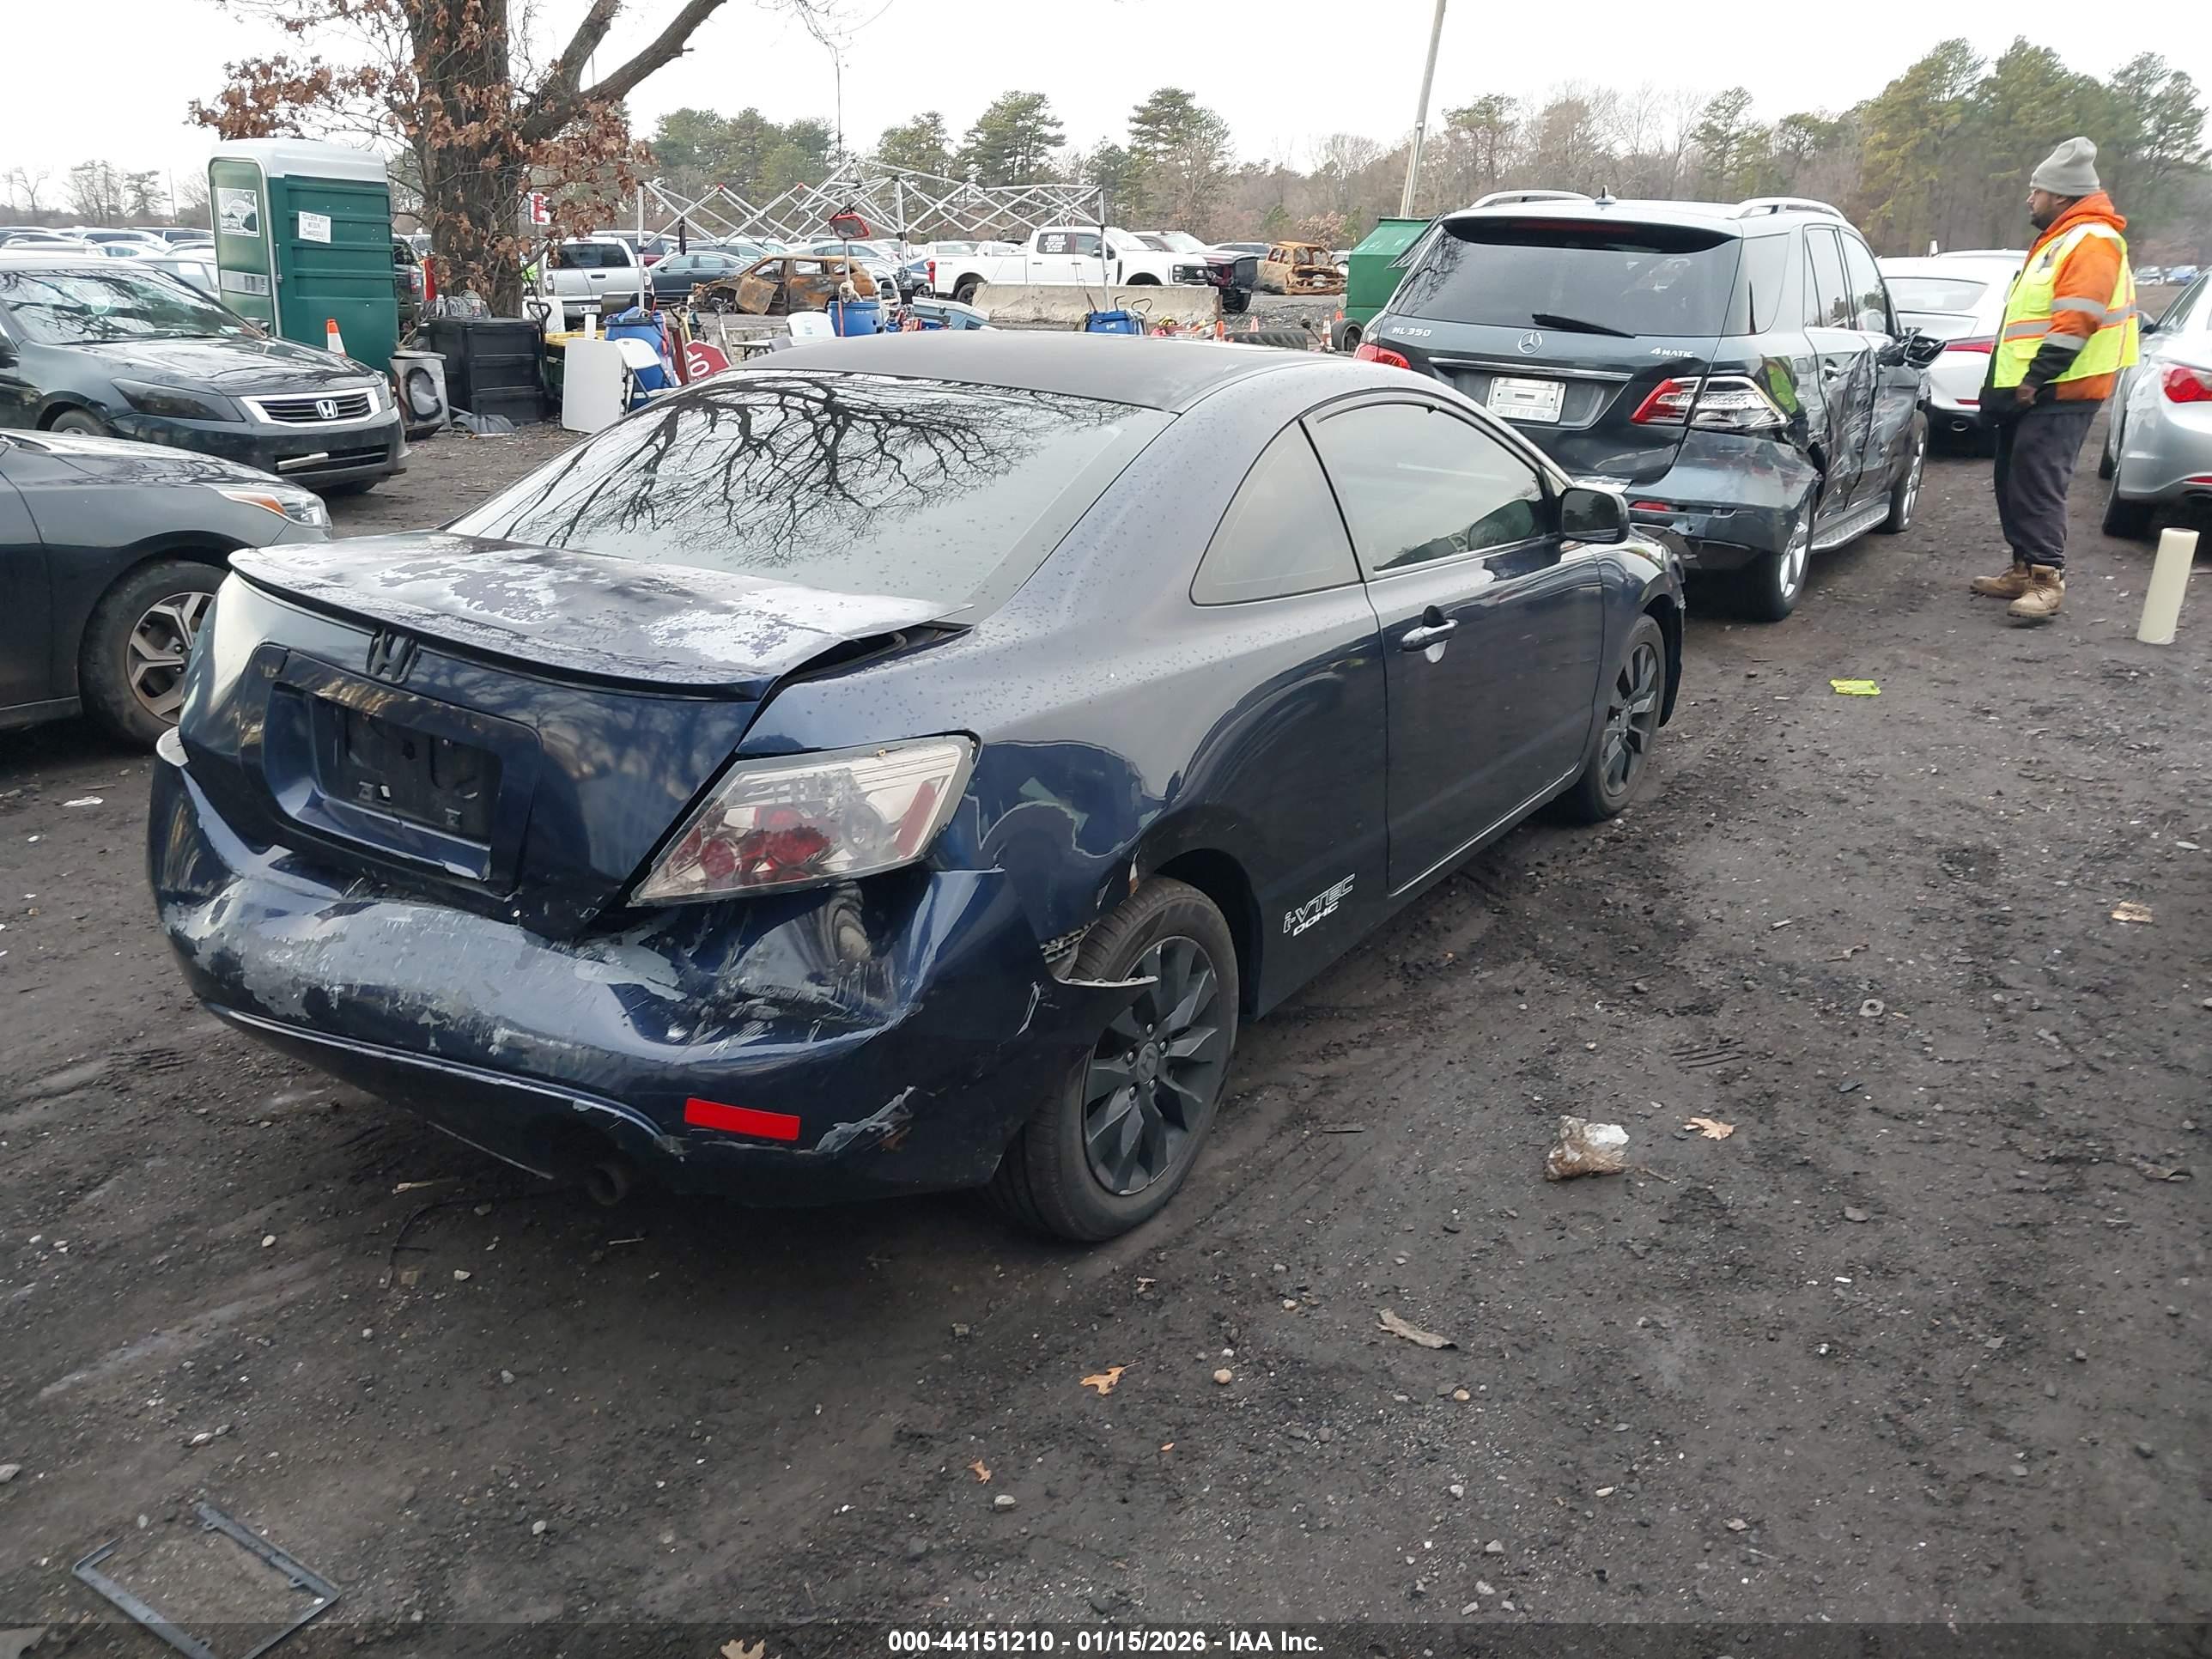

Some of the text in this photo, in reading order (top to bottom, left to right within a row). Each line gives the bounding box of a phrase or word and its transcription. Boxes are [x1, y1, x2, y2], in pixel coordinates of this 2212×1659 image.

[1392, 326, 1432, 337] ML 350
[1283, 872, 1356, 933] i-VTEC
[1292, 901, 1340, 937] DOHC
